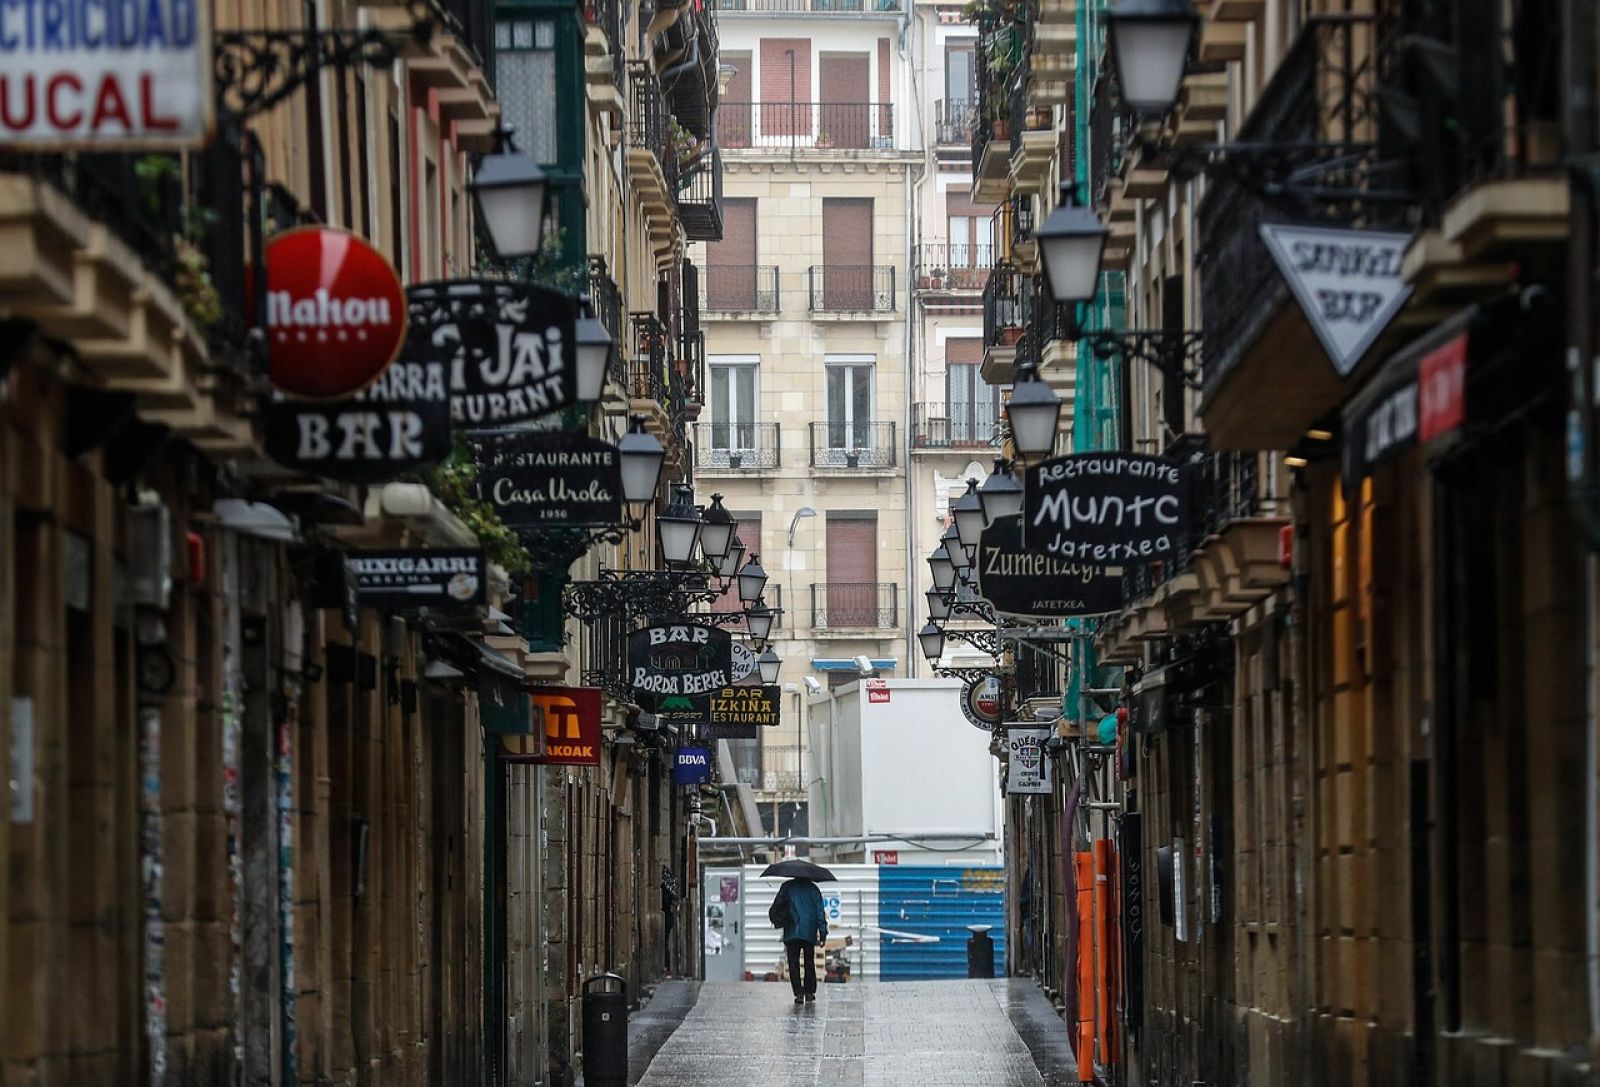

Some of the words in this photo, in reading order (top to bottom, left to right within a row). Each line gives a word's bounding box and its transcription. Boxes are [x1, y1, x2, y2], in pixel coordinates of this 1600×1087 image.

[0, 72, 182, 131] UCAL
[297, 411, 424, 460] BAR
[493, 451, 613, 466] RSTAURANTE
[492, 477, 547, 507] Casa
[548, 477, 613, 503] Urola
[1047, 532, 1171, 560] Jatetxea
[1031, 600, 1086, 609] JATETXEA
[649, 626, 710, 646] BAR
[633, 667, 680, 695] BORDA
[721, 688, 764, 698] BAR
[672, 712, 704, 720] SPORT
[678, 755, 706, 765] BBVA
